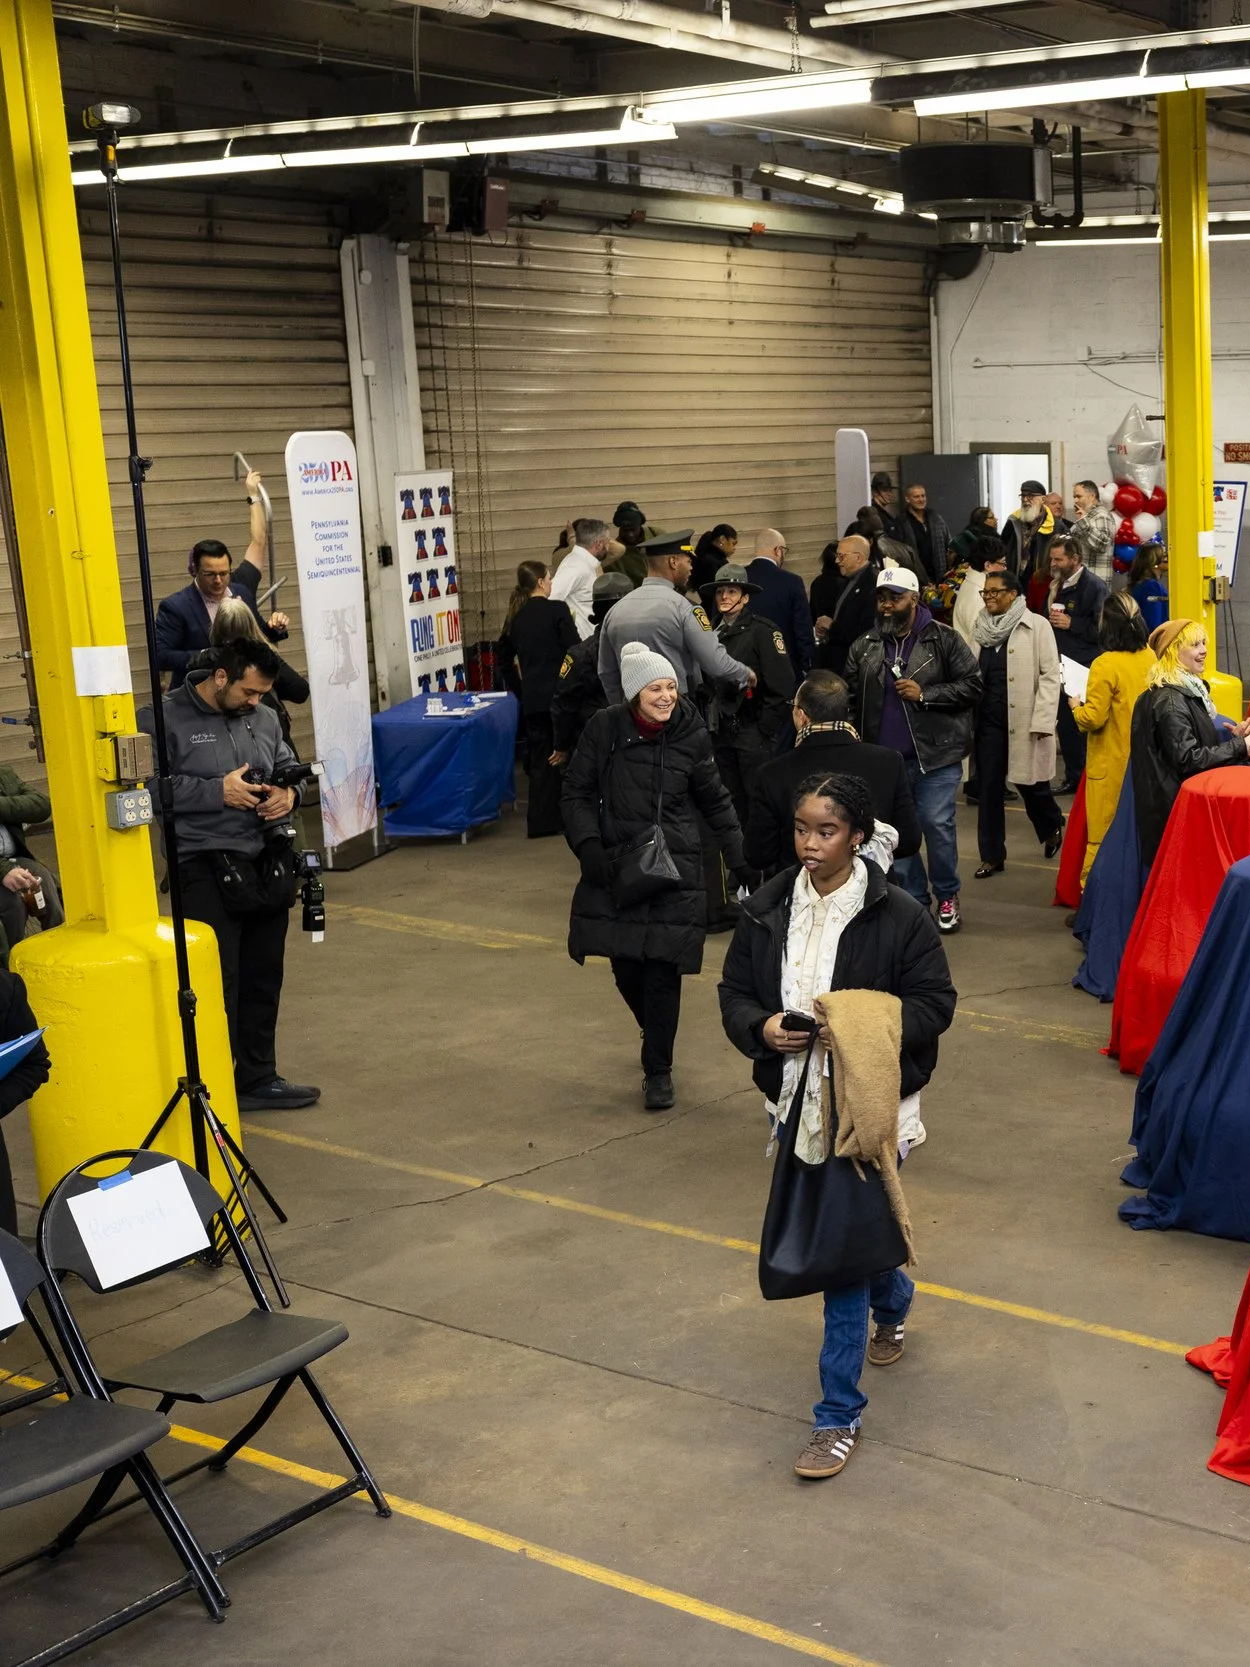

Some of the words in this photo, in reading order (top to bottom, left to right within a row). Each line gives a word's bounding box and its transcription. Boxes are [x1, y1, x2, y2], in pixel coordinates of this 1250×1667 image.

[1225, 452, 1236, 461] NO
[330, 459, 353, 482] PA
[311, 520, 349, 529] PENNSYLVANIA
[314, 532, 349, 542] COMMISSION
[322, 545, 333, 553] FOR
[334, 544, 344, 552] THE
[315, 557, 336, 567] UNITED
[336, 555, 353, 564] STATES
[306, 565, 361, 580] SEMIQUINCENTENNIAL
[410, 614, 434, 654] RING
[435, 611, 446, 647] IT
